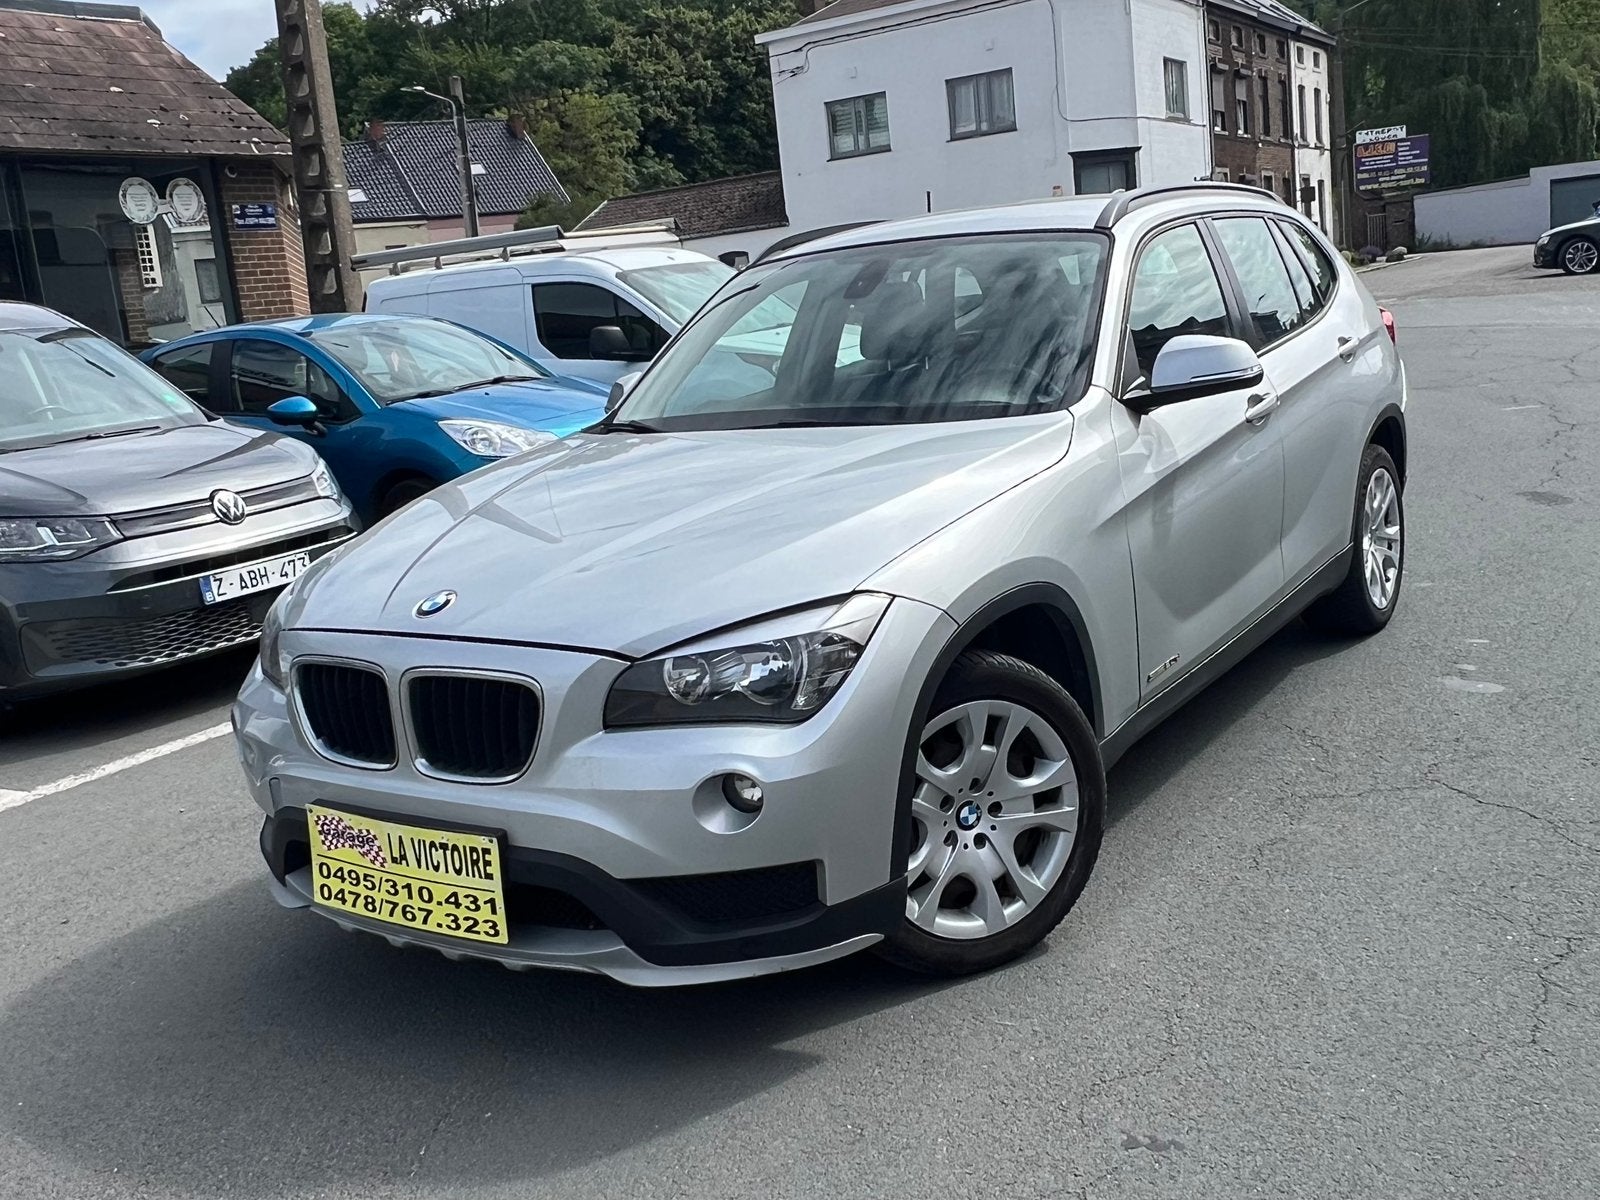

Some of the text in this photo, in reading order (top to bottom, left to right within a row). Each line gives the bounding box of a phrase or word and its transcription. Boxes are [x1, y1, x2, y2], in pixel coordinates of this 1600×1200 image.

[321, 822, 494, 881] Garage LA VICTOIRE
[318, 861, 498, 915] 0495/310.431
[319, 883, 500, 937] 0478/767.323
